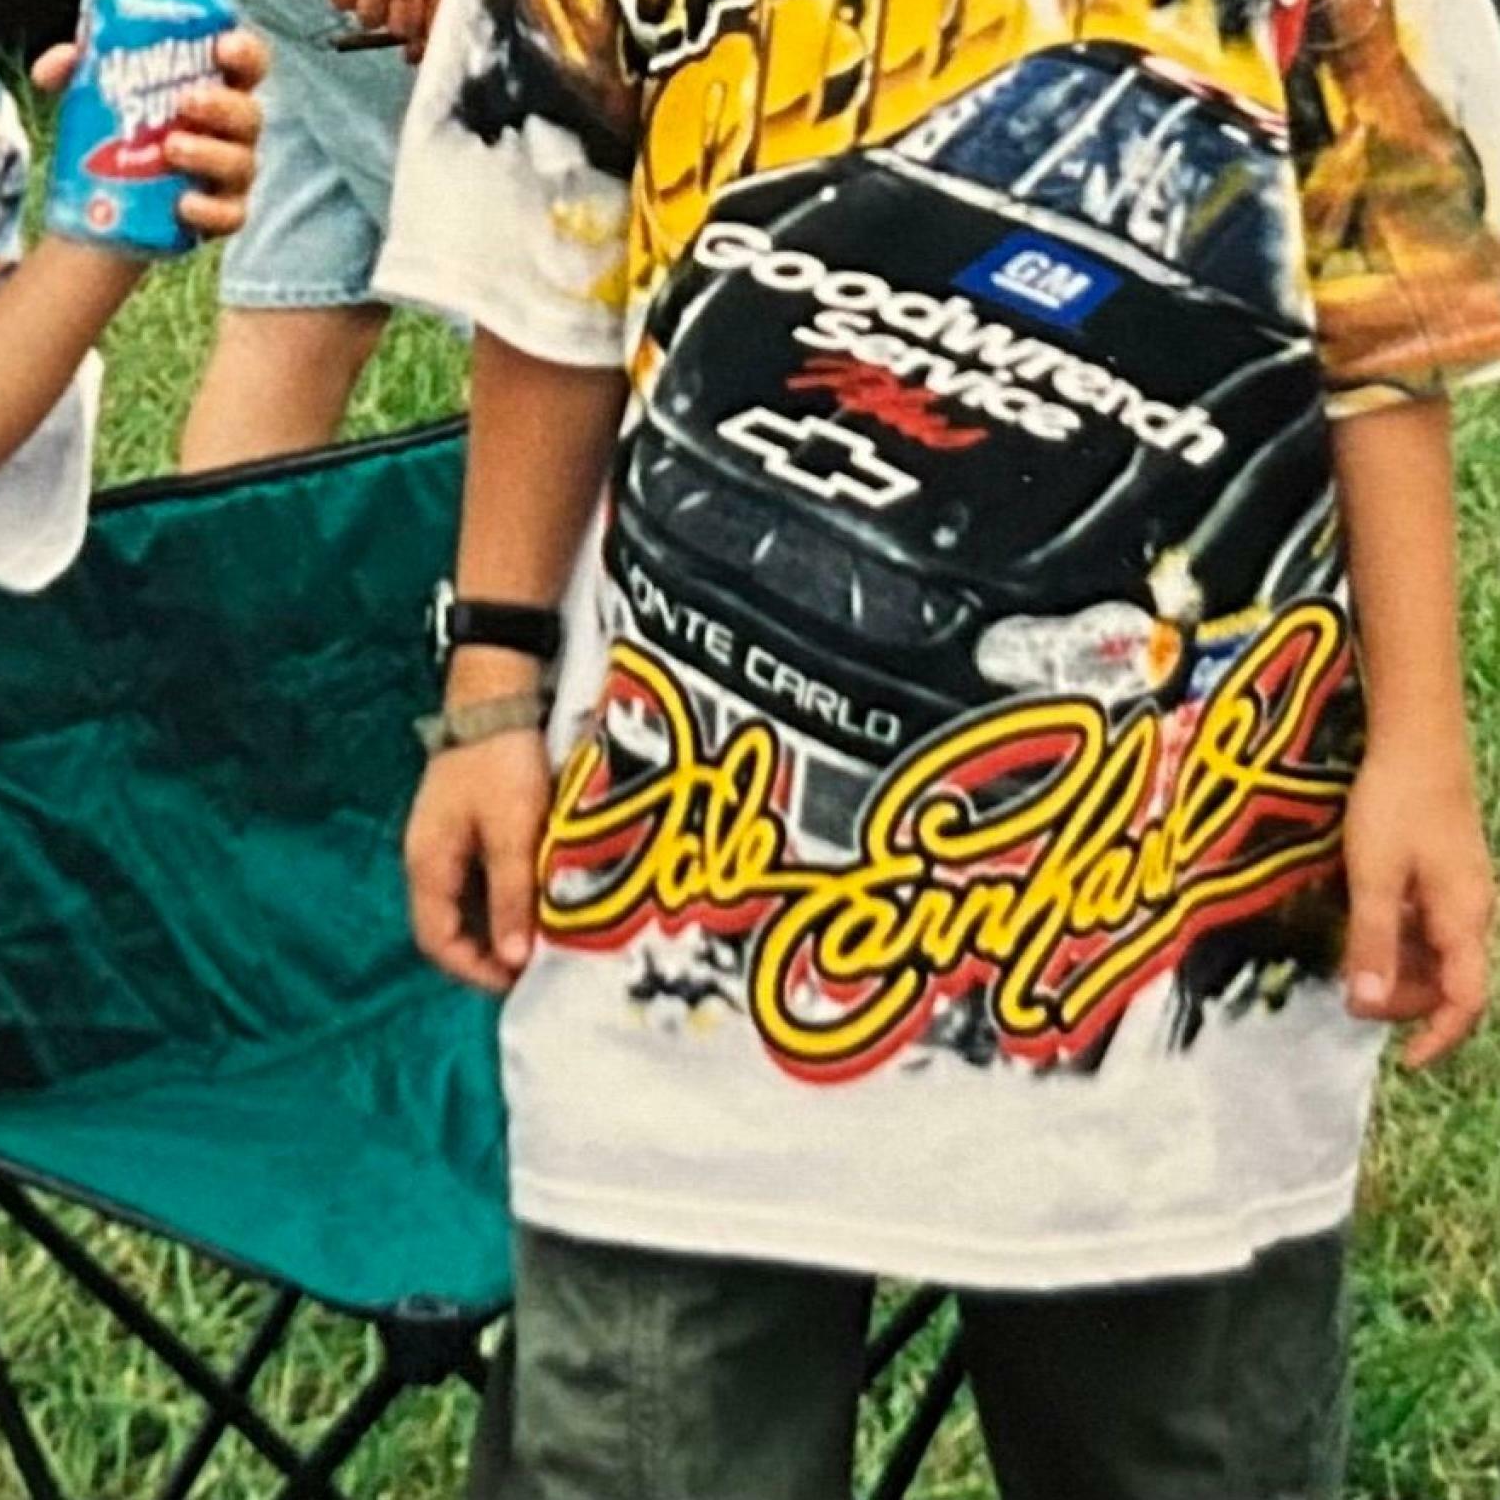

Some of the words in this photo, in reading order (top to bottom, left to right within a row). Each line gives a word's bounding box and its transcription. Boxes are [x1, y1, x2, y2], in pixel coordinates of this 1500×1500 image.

[1002, 250, 1094, 303] GM
[694, 222, 1226, 466] Goodwrench
[792, 309, 1083, 442] Service
[744, 645, 900, 745] CARLO
